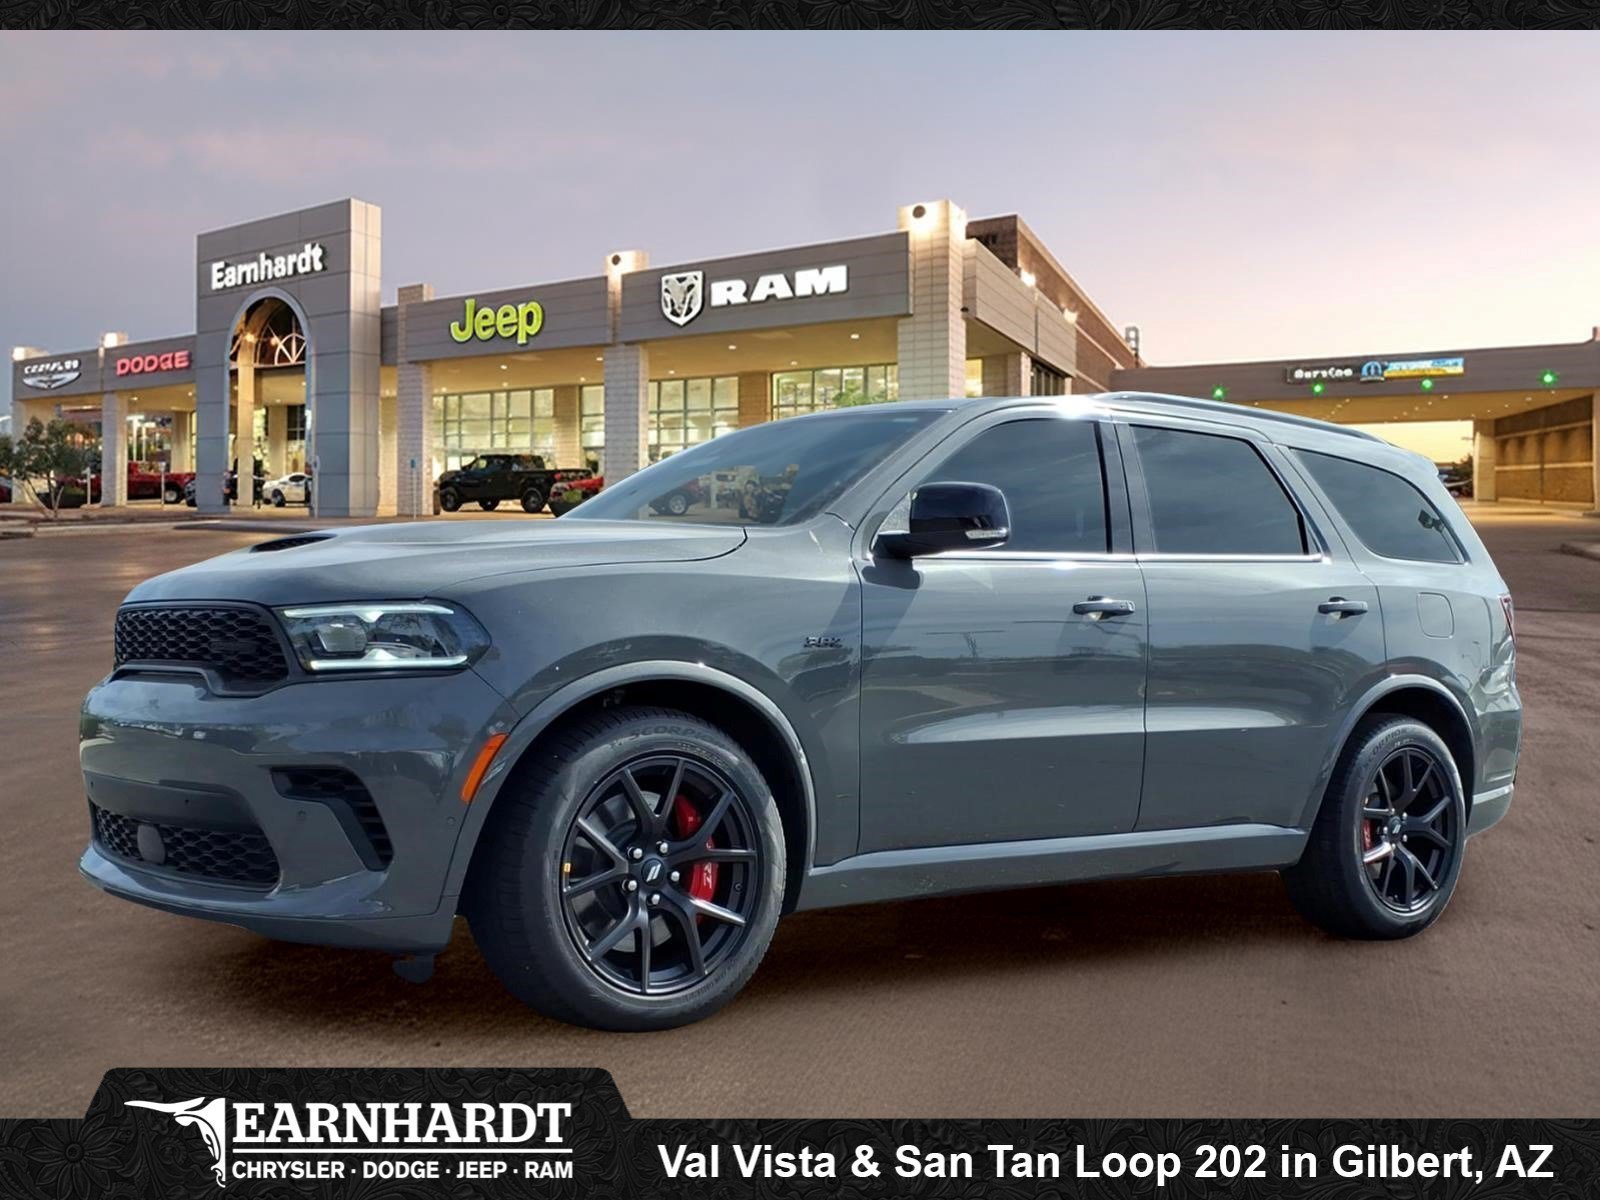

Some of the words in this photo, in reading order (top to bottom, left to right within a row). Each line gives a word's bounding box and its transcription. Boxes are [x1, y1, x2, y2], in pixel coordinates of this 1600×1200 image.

[211, 243, 323, 290] Earnhardt
[711, 265, 848, 306] RAM
[450, 299, 544, 345] Jeep
[116, 351, 190, 376] DODGE
